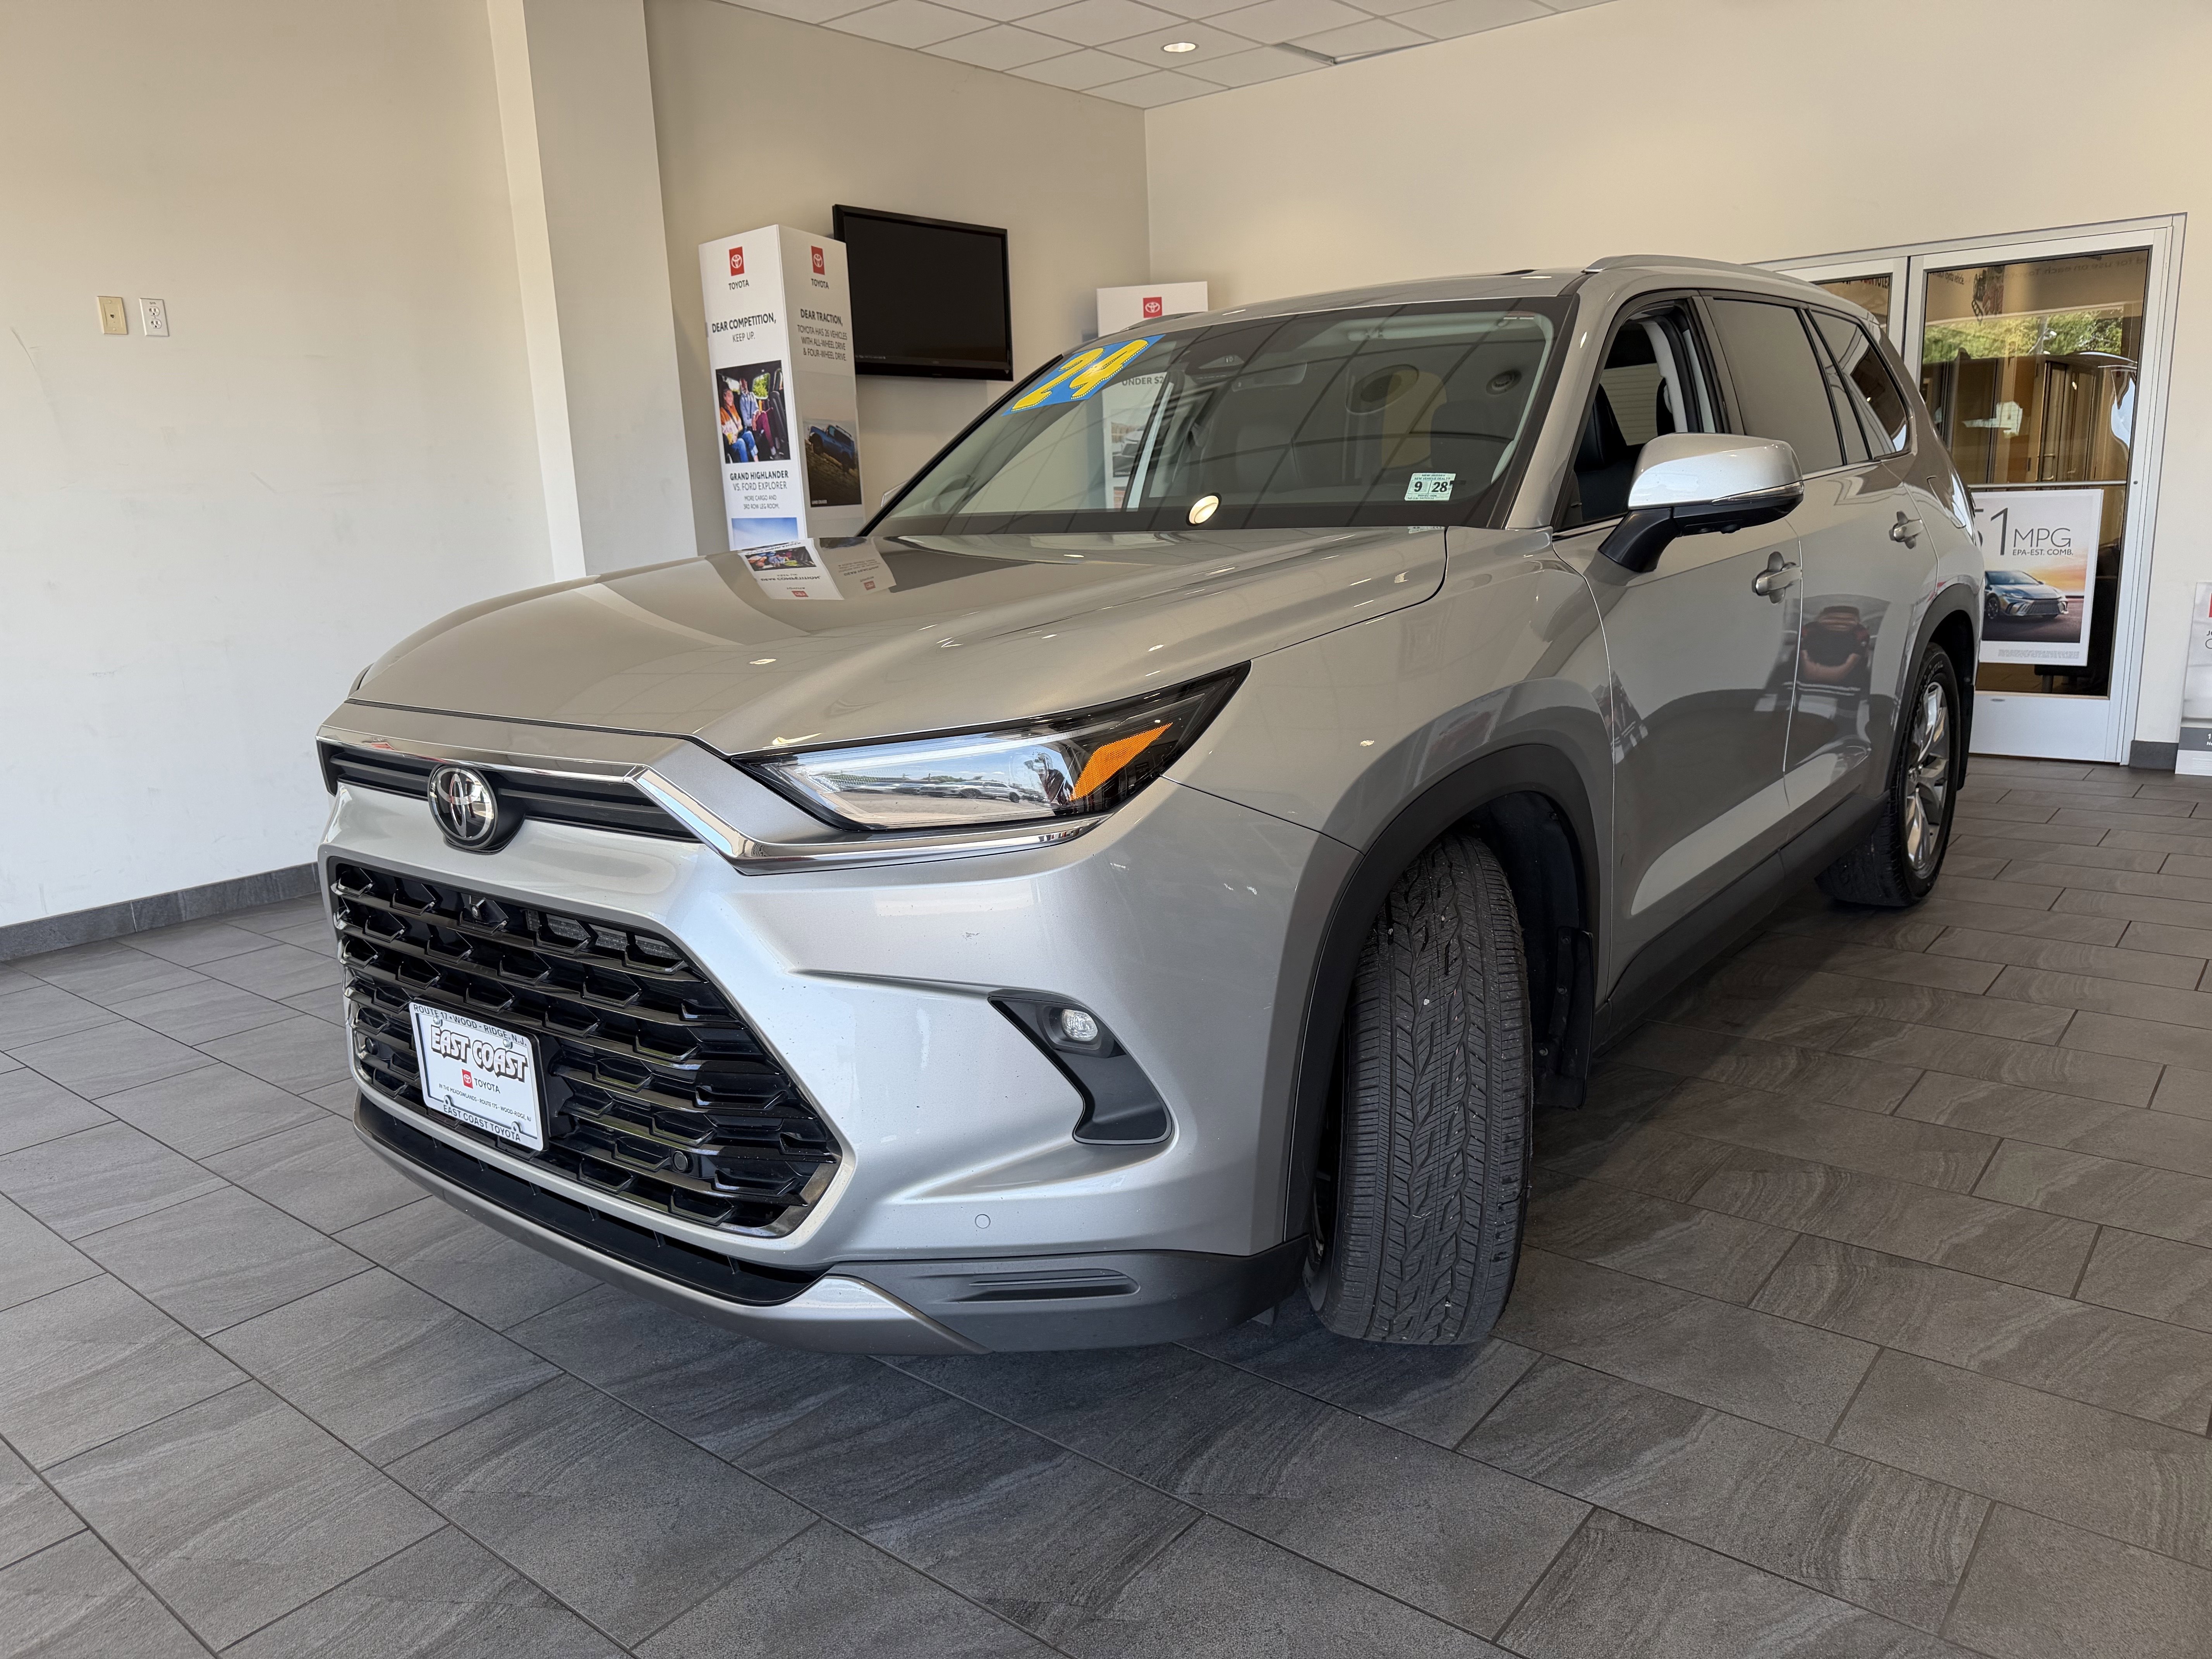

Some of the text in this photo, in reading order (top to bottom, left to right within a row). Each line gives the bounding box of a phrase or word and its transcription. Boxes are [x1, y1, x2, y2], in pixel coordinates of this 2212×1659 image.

[728, 279, 749, 290] TOYOTA
[811, 278, 829, 289] TOYOTA
[712, 312, 776, 333] DEAR COMPETITION,
[800, 309, 843, 326] DEAR TRACTION,
[732, 331, 755, 342] KEEP UP.
[797, 325, 814, 334] TOYOTA
[815, 328, 824, 336] HAS
[830, 330, 847, 340] VEHICLES
[814, 338, 835, 349] ALL-WHEEL
[835, 342, 846, 350] DRIVE
[807, 349, 835, 359] FOUR-WHEEL
[1122, 377, 1152, 386] UNDER
[730, 470, 789, 481] GRAND HIGHLANDER
[733, 481, 787, 491] VS. FORD EXPLORER
[1414, 481, 1448, 493] 9 28
[2014, 528, 2071, 548] MPG
[414, 1004, 439, 1017] ROUTE
[452, 1015, 477, 1028] WOOD
[484, 1025, 510, 1041] RIDGE,
[511, 1034, 527, 1046] N.J.
[431, 1025, 528, 1082] EAST COAST
[474, 1078, 500, 1094] TOYOTA
[450, 1087, 477, 1101] MEADOWLANDS
[479, 1099, 491, 1107] ROUTE
[500, 1106, 526, 1121] WOOD-RIDGE,
[443, 1104, 521, 1142] EAST COAST TOYOTA
